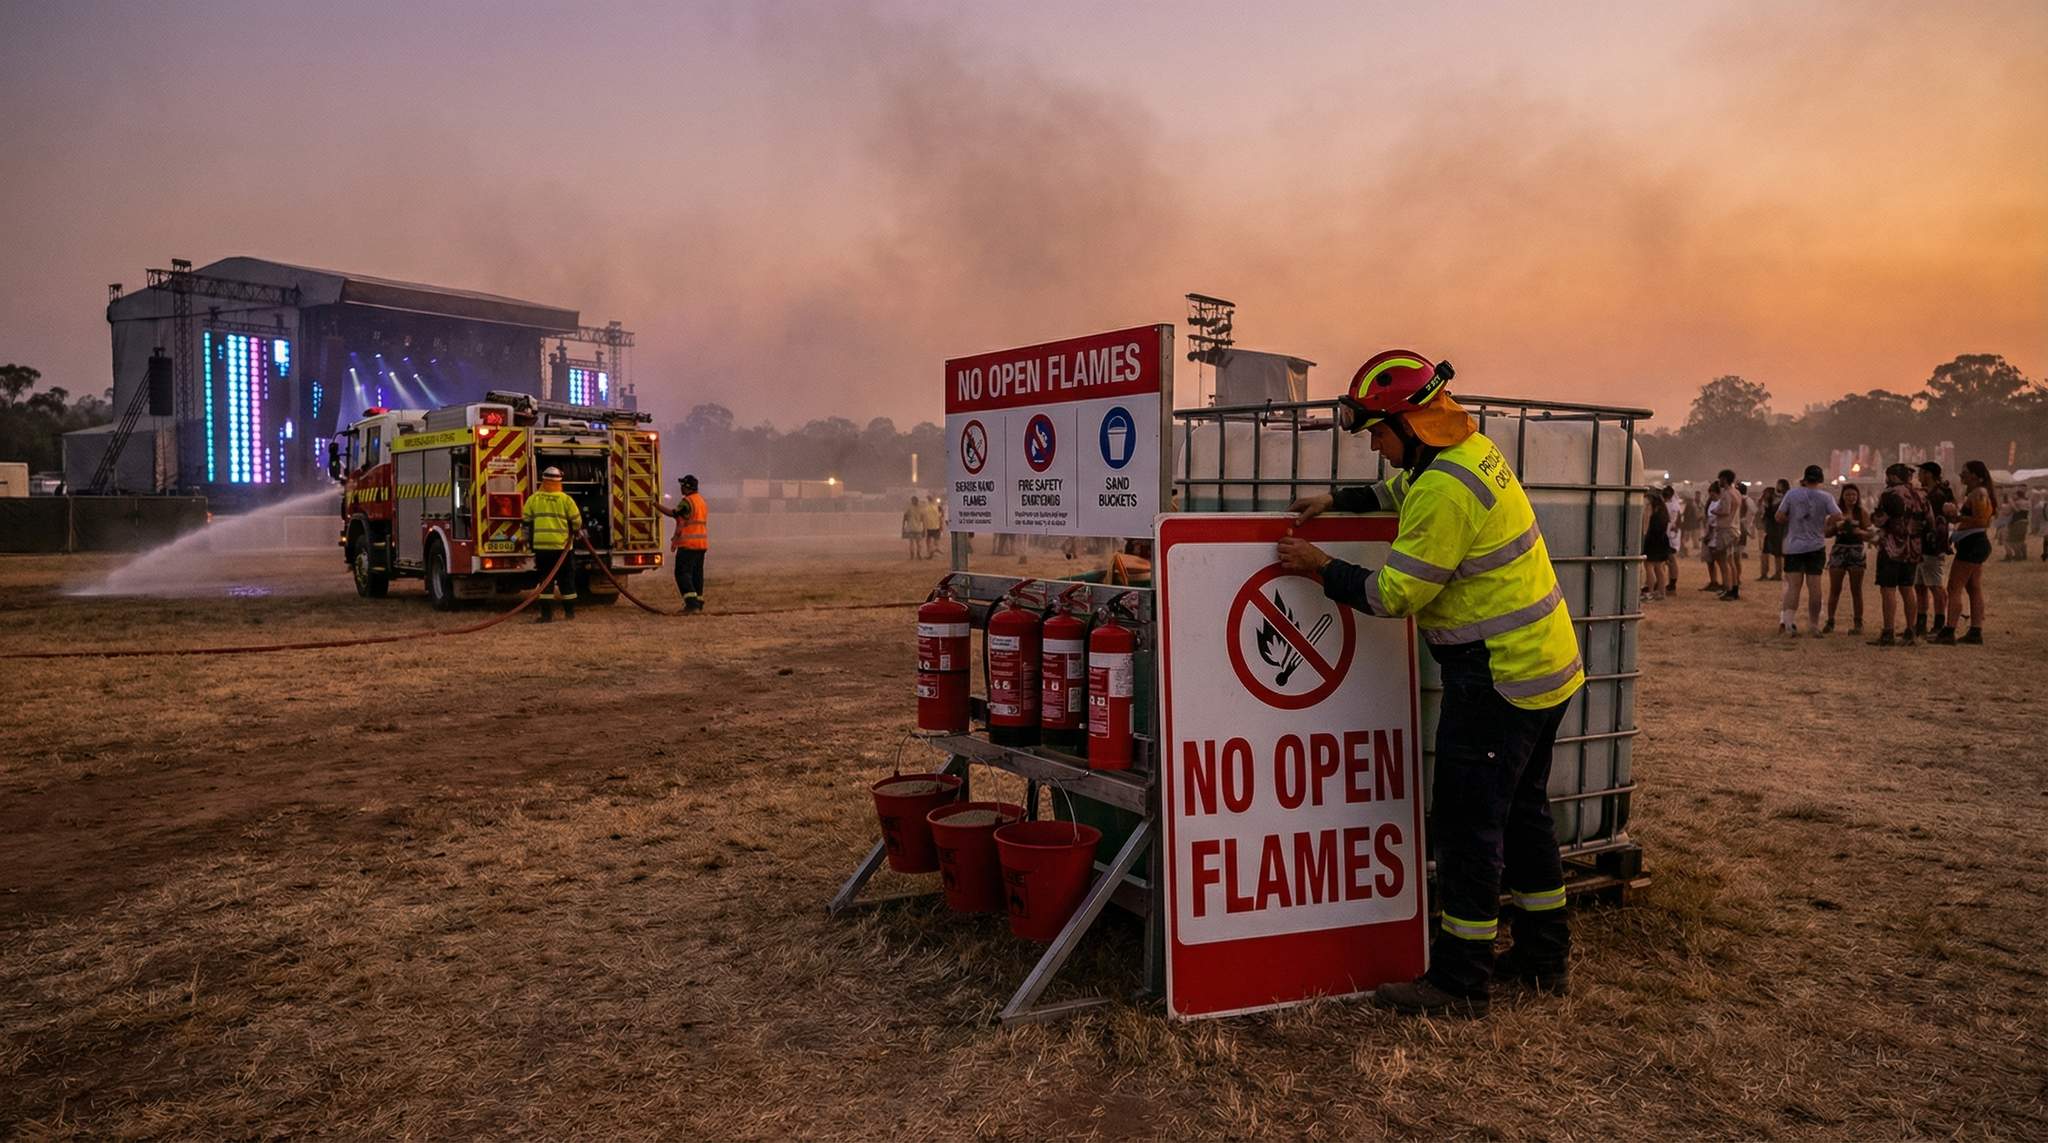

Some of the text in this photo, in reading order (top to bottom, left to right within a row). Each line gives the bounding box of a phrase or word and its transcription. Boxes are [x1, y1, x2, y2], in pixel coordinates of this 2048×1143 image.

[958, 343, 1141, 401] NO OPEN FLAMES
[1035, 479, 1063, 491] SAFETY
[1099, 494, 1137, 507] BUCKETS
[1106, 476, 1129, 491] SAND
[1183, 729, 1405, 816] NO OPEN
[1192, 823, 1405, 918] FLAMES
